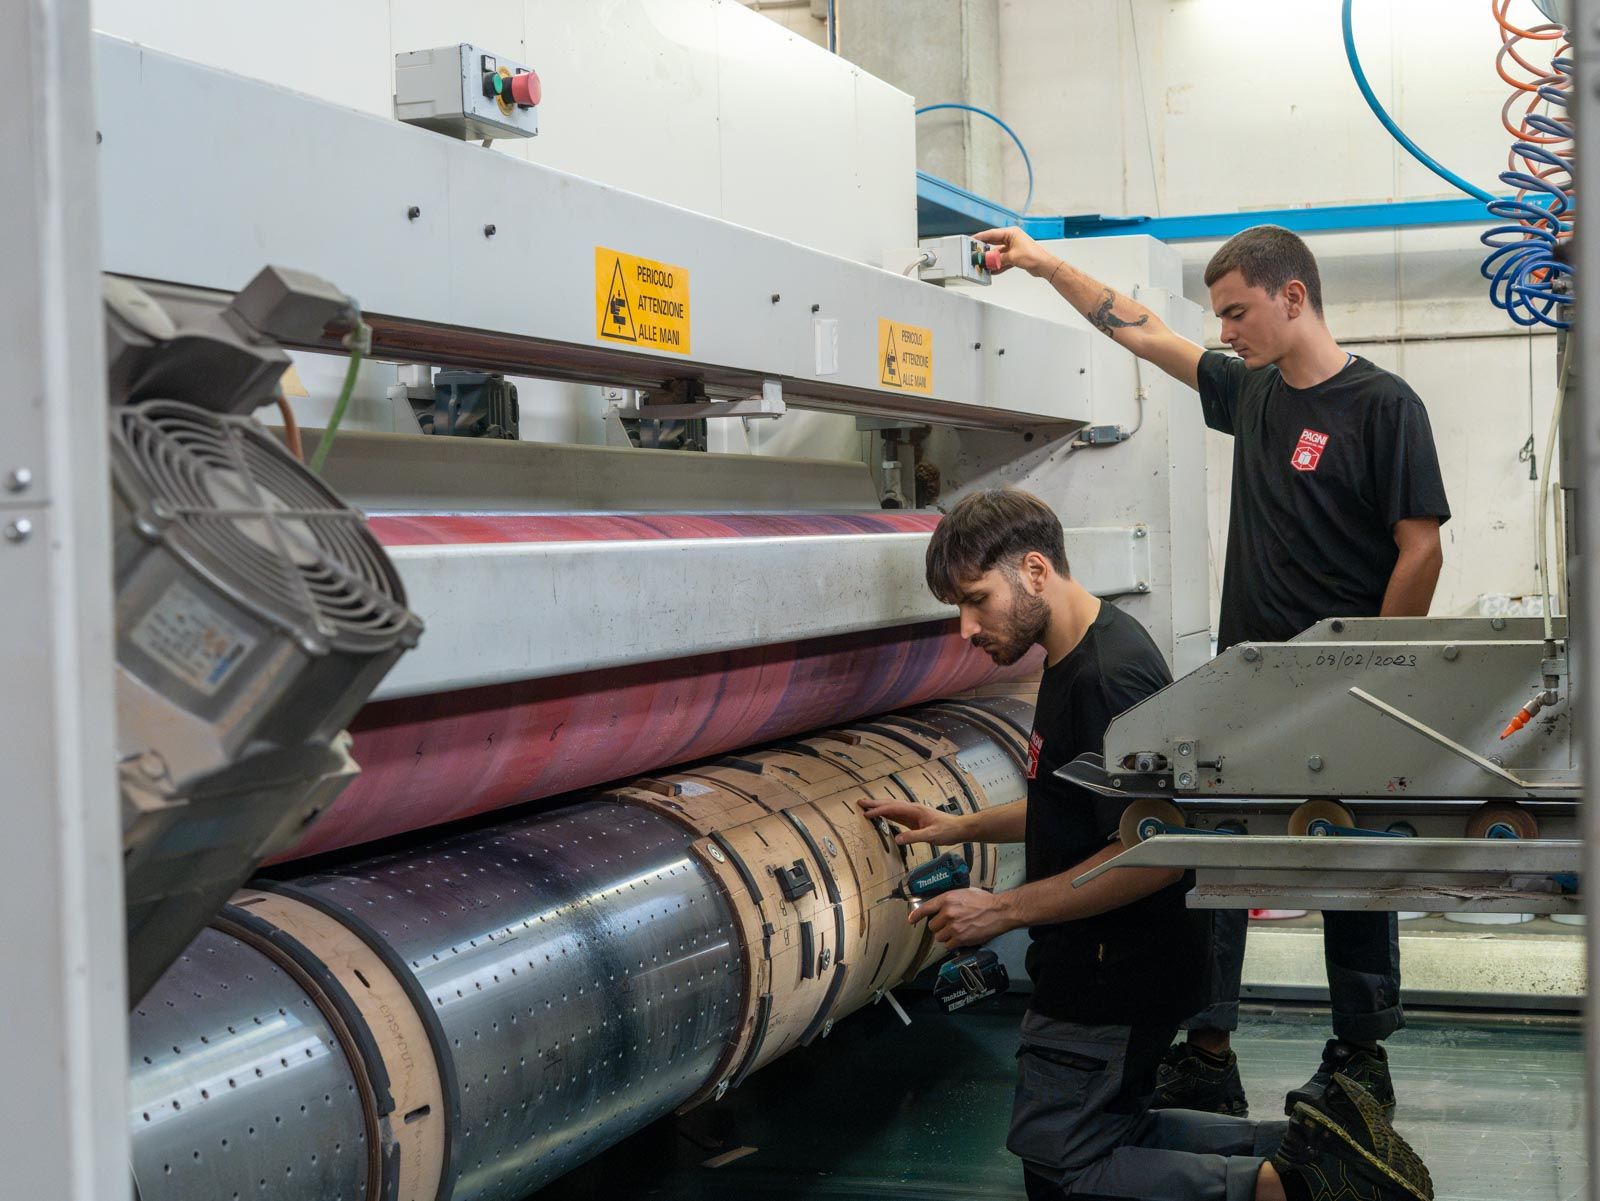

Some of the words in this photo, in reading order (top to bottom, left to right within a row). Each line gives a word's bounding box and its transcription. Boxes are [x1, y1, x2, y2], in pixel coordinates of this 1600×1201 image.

[637, 265, 674, 289] PERICOLO
[637, 294, 684, 319] ATTENZIONE
[638, 323, 658, 342] ALLE
[659, 327, 680, 346] MANI
[901, 329, 923, 346] PERICOLO
[902, 351, 929, 369] ATTENZIONE
[902, 373, 914, 387] ALLE
[914, 375, 927, 389] MANI
[1300, 430, 1329, 446] PAGNI
